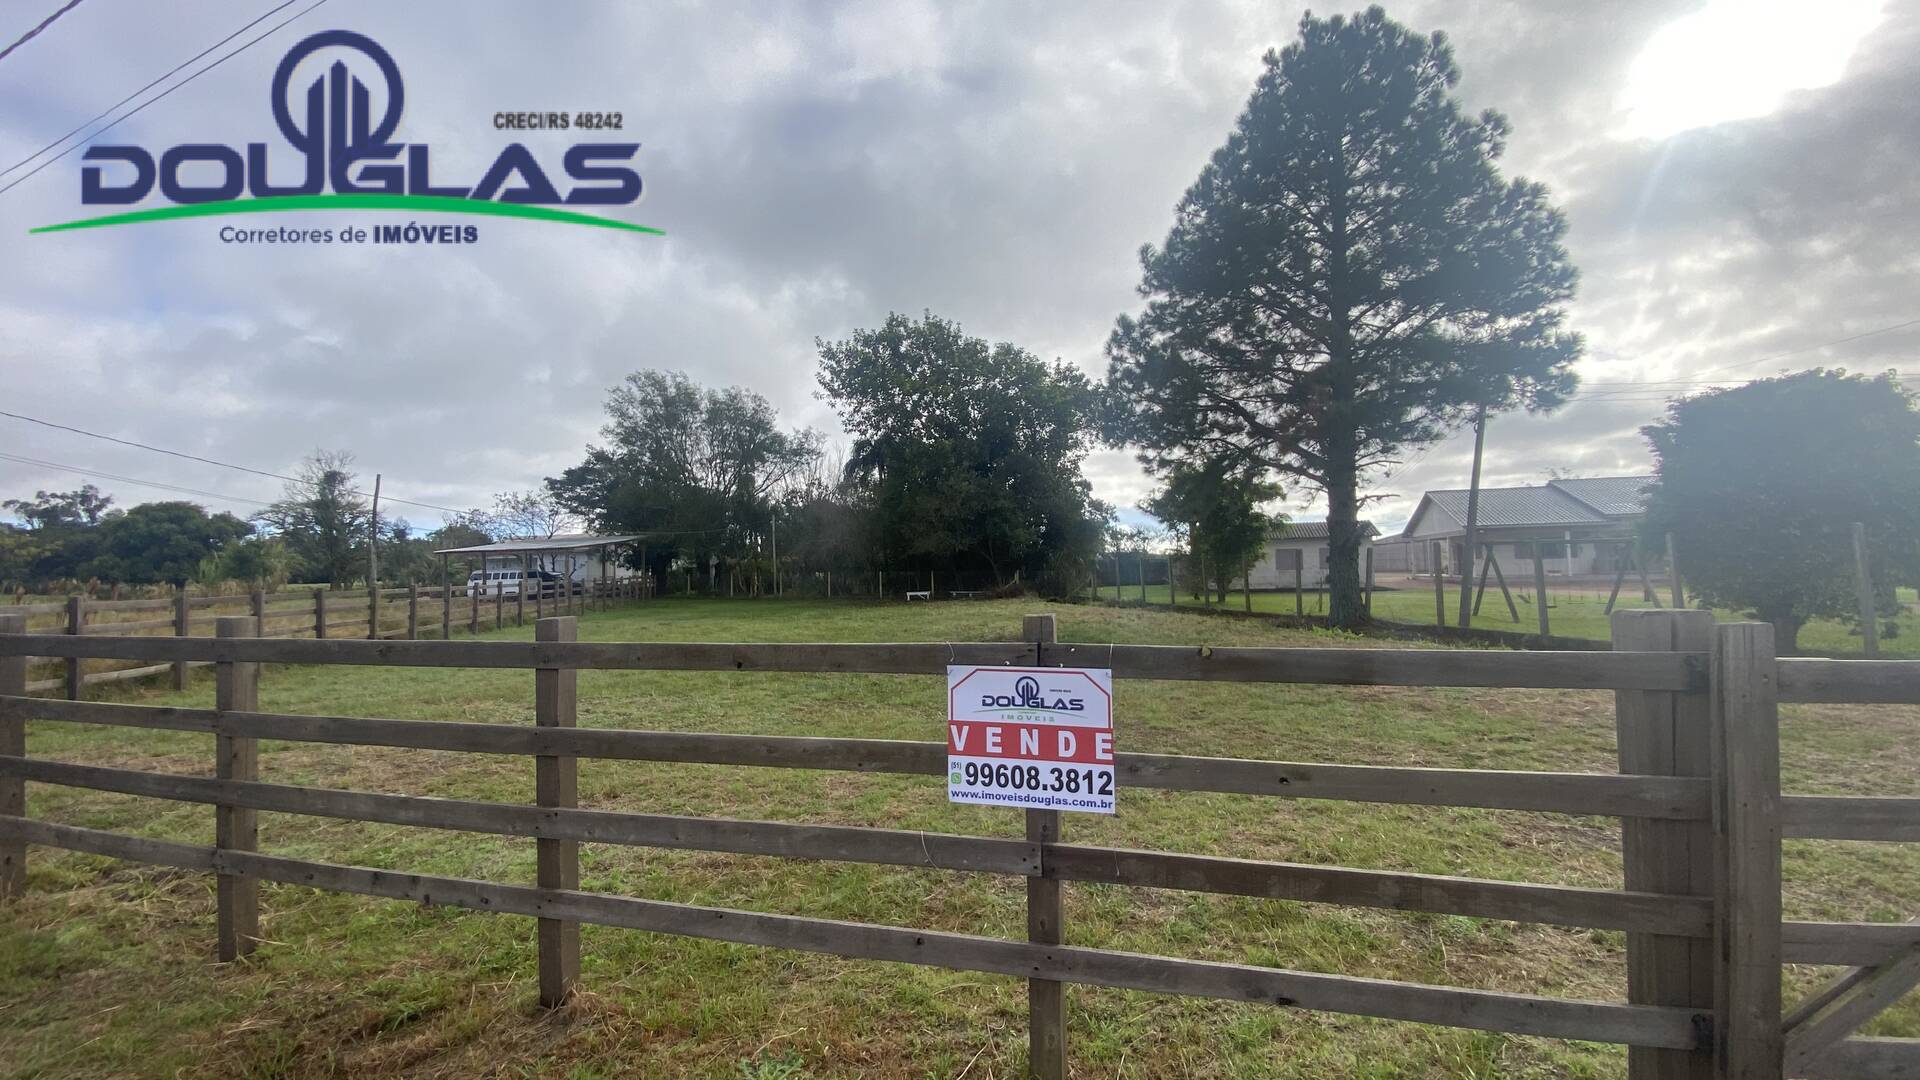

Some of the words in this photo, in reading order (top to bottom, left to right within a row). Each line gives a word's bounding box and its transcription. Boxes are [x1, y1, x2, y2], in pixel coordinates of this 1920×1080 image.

[981, 694, 1085, 711] DOUGLAS
[951, 725, 1113, 760] VENDE
[965, 761, 1113, 796] 99608.3812
[951, 790, 1113, 809] www.imoveisdouglas.com.br
